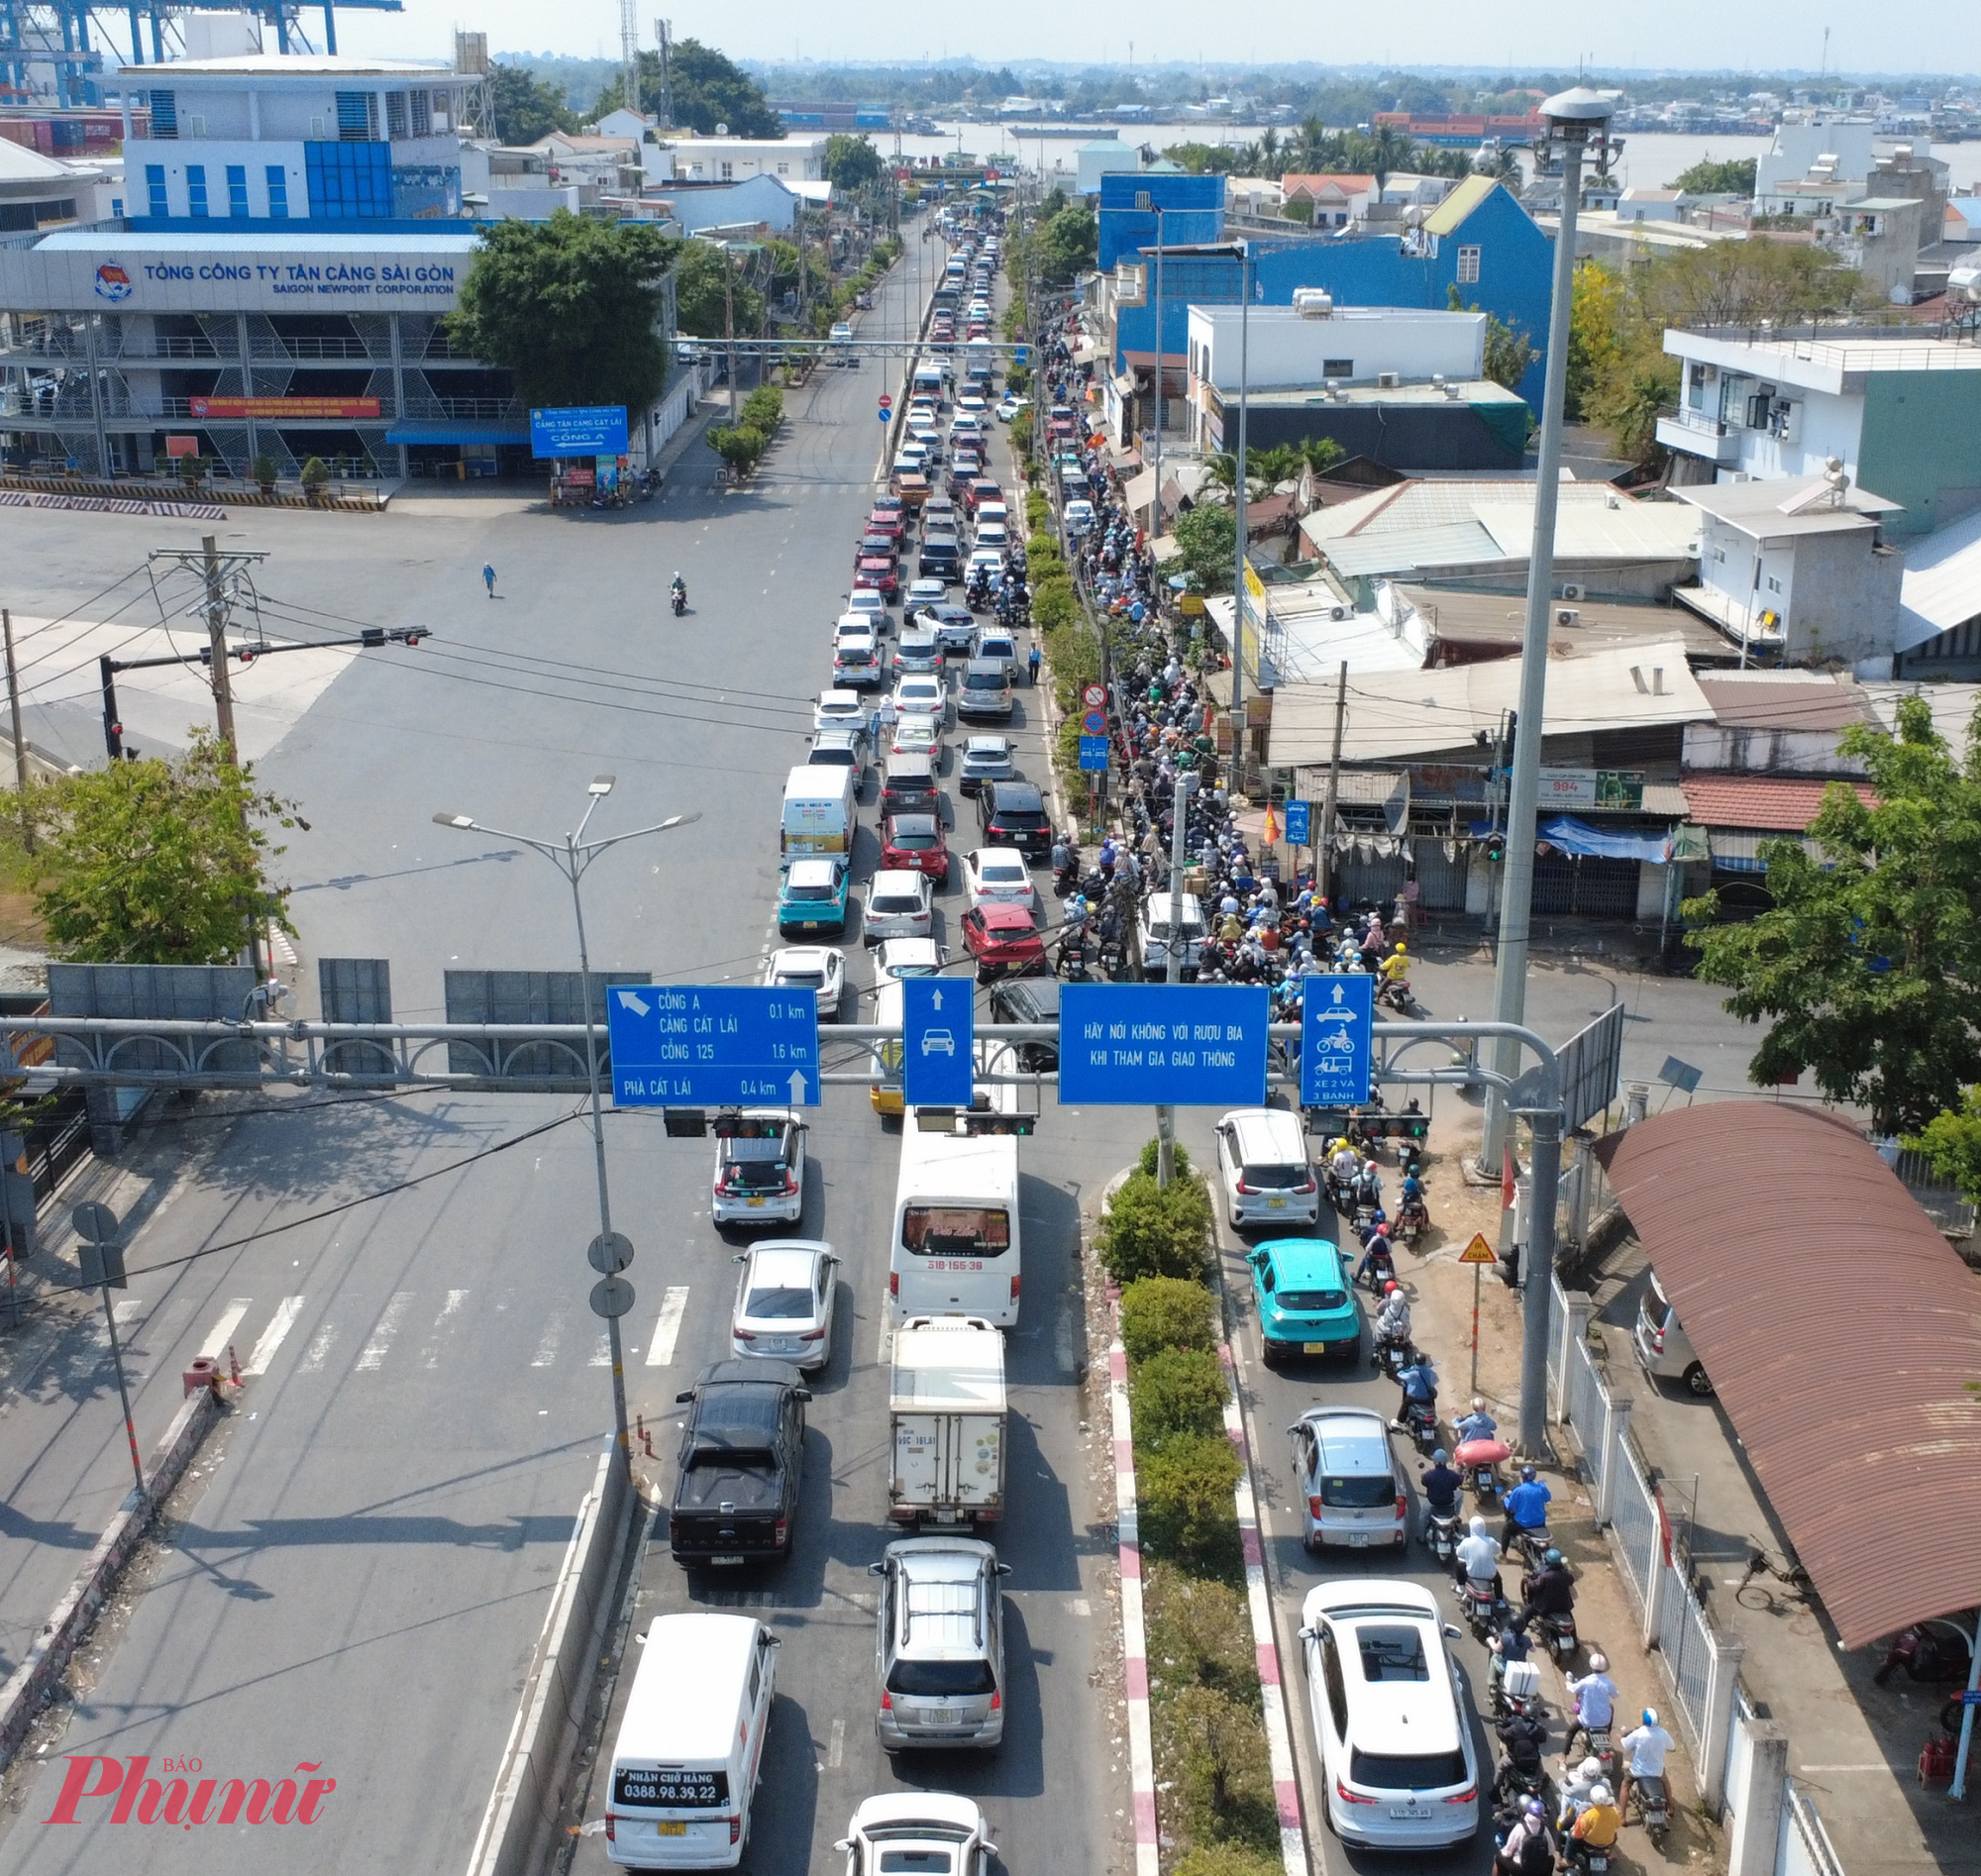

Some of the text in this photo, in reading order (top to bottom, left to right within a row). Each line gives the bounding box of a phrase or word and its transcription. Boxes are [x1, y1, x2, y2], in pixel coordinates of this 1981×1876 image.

[144, 261, 194, 280] TỔNG
[199, 263, 252, 280] CÔNG
[257, 265, 278, 280] TY
[285, 262, 320, 281] TÂN
[326, 262, 376, 281] CẢNG
[381, 262, 411, 281] SÀI
[415, 262, 455, 281] GÒN
[272, 284, 455, 295] SAIGON NEWPORT CORPORATION
[1552, 781, 1579, 791] 994
[658, 989, 805, 1019] CỔNG A 0.1 km
[660, 1013, 738, 1033] CẢNG CÁT LÁI
[1084, 1020, 1243, 1043] HÃY NÓI KHÔNG VỚI RƯỢU BIA
[661, 1038, 807, 1060] CỔNG 125 1.6 km
[1091, 1049, 1235, 1067] KHI THAM GIA GIAO THÔNG
[624, 1077, 777, 1095] PHÀ CÁT LÁI 0.4 km
[683, 1771, 713, 1783] HÀNG
[624, 1784, 716, 1799] 0388.98.39.22
